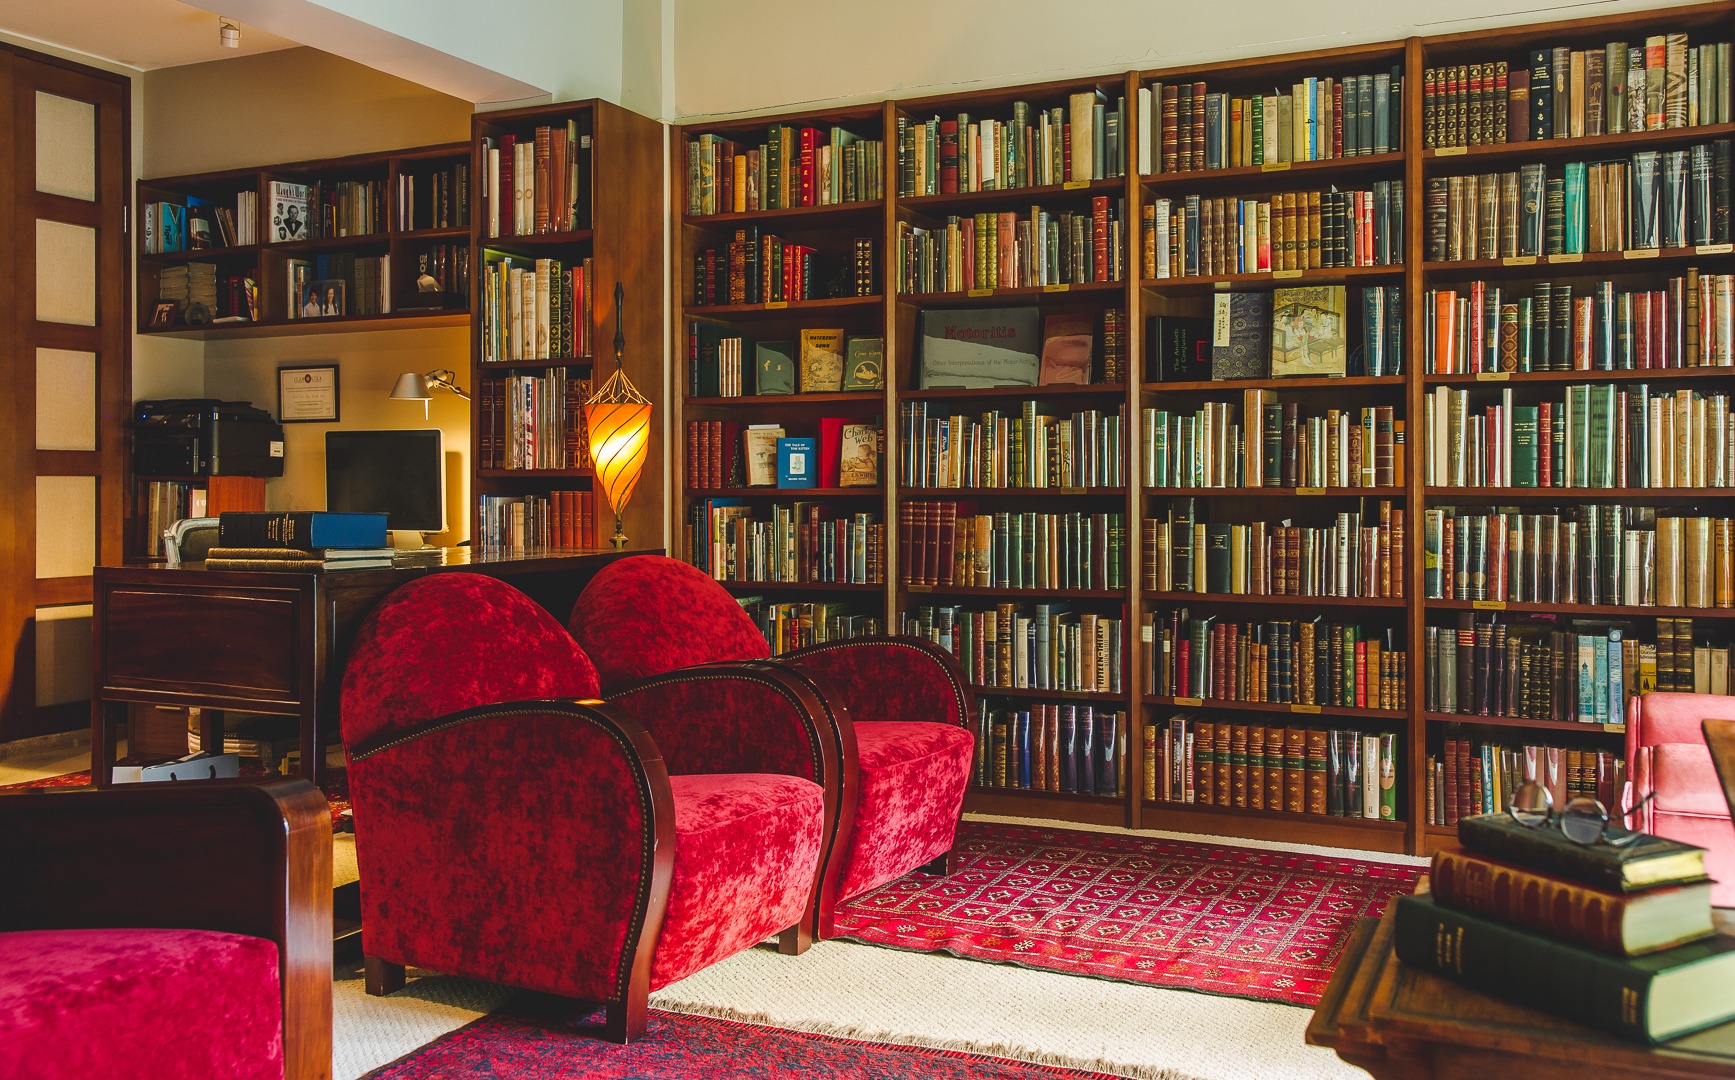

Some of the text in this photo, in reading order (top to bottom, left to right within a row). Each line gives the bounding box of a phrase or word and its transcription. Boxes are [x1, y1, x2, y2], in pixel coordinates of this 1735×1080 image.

[294, 185, 307, 199] Worl
[164, 225, 172, 245] Tiger
[944, 326, 1017, 340] Motoritis
[855, 435, 874, 444] Web
[1610, 650, 1620, 683] BROKEN ROAD
